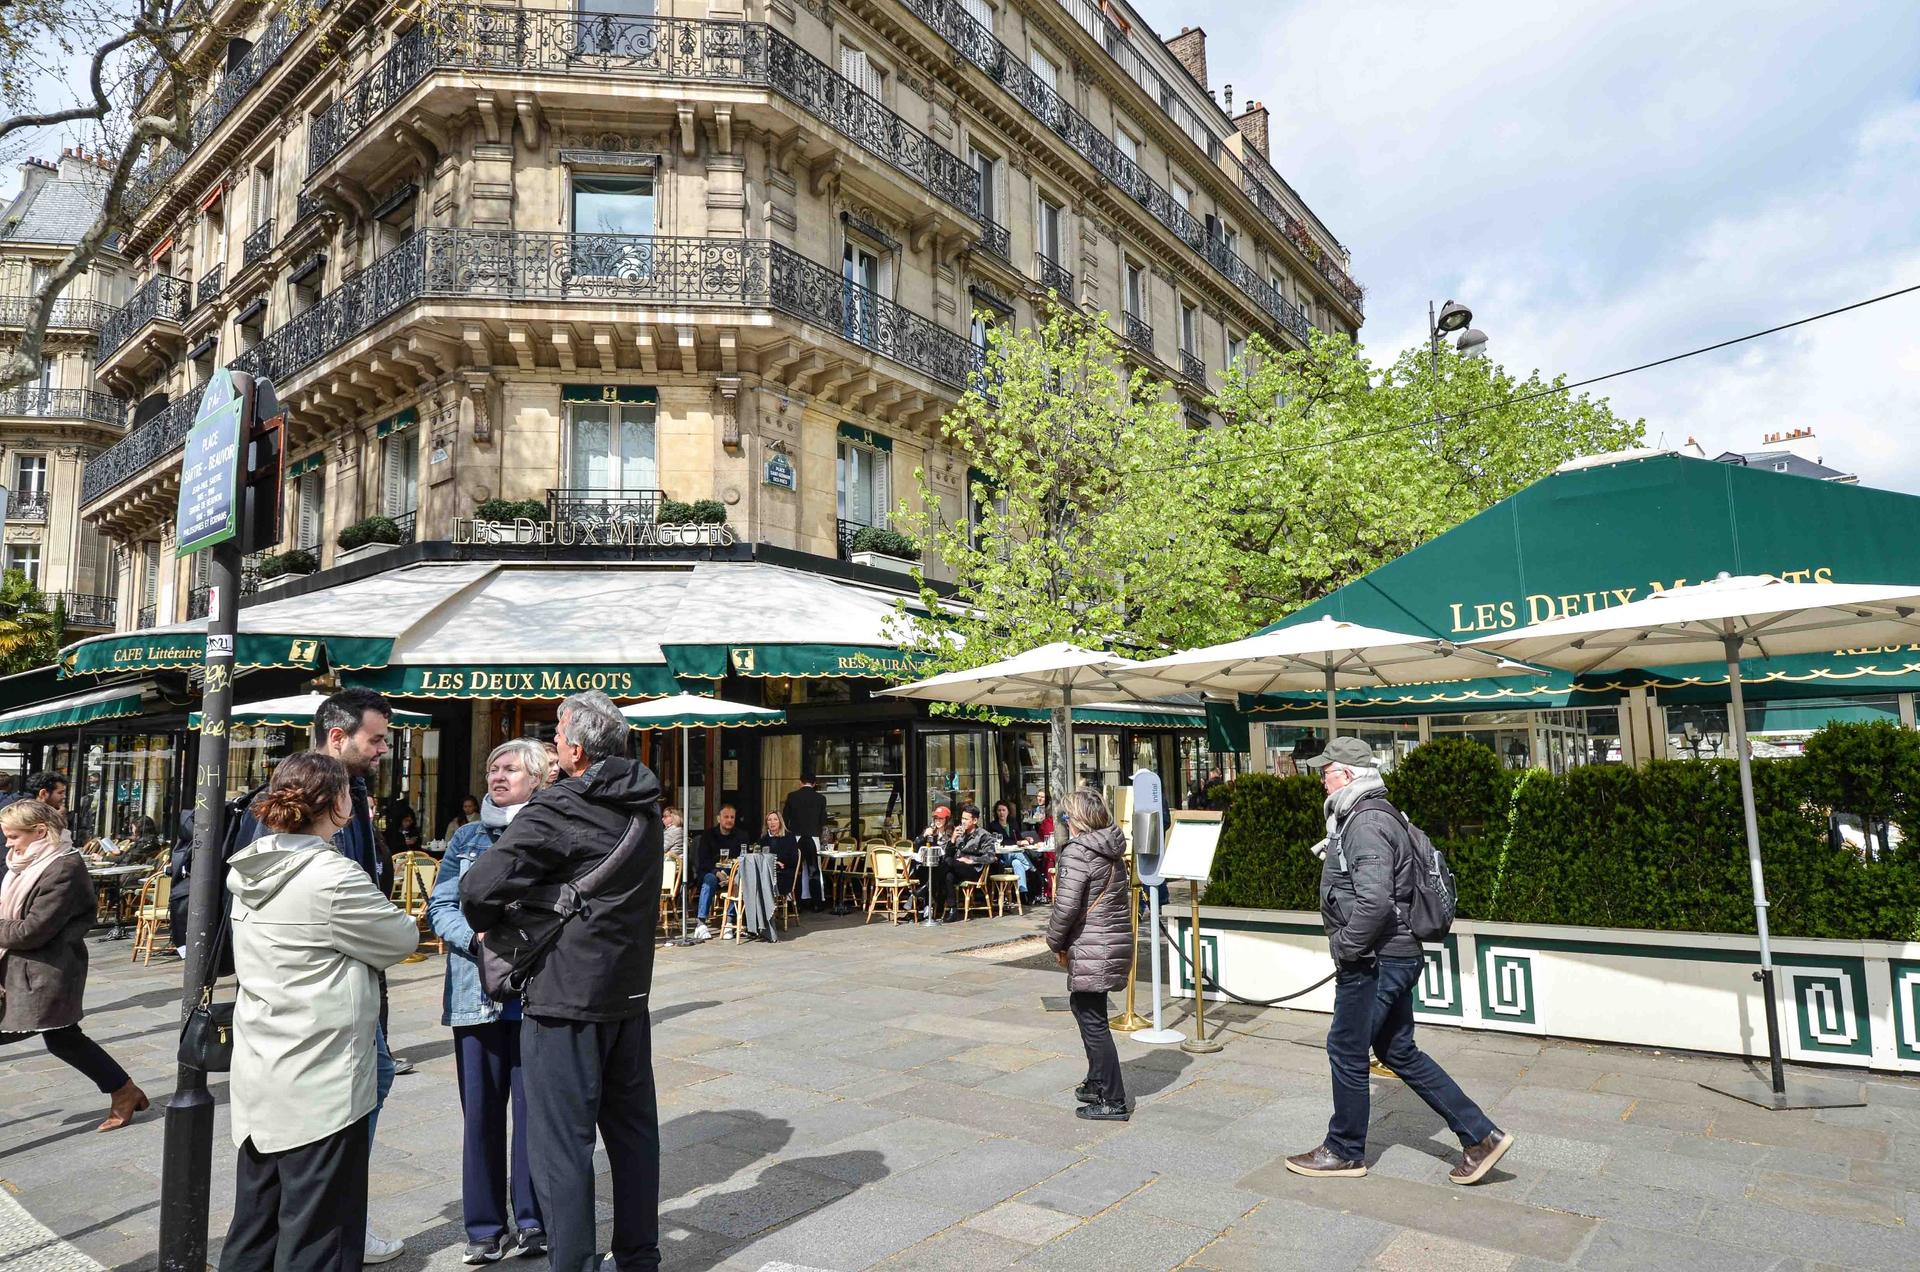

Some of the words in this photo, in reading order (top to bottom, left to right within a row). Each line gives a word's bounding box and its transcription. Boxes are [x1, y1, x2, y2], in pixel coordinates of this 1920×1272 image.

[202, 431, 219, 453] PLACE
[451, 516, 502, 545] LES
[512, 517, 595, 546] DEUX
[606, 519, 736, 547] MAGOTS
[1449, 600, 1517, 633] LES
[1526, 587, 1637, 626] DEUX
[147, 645, 202, 661] Littéraire
[420, 671, 464, 690] LES
[469, 671, 535, 691] DEUX
[539, 671, 632, 691] MAGOTS
